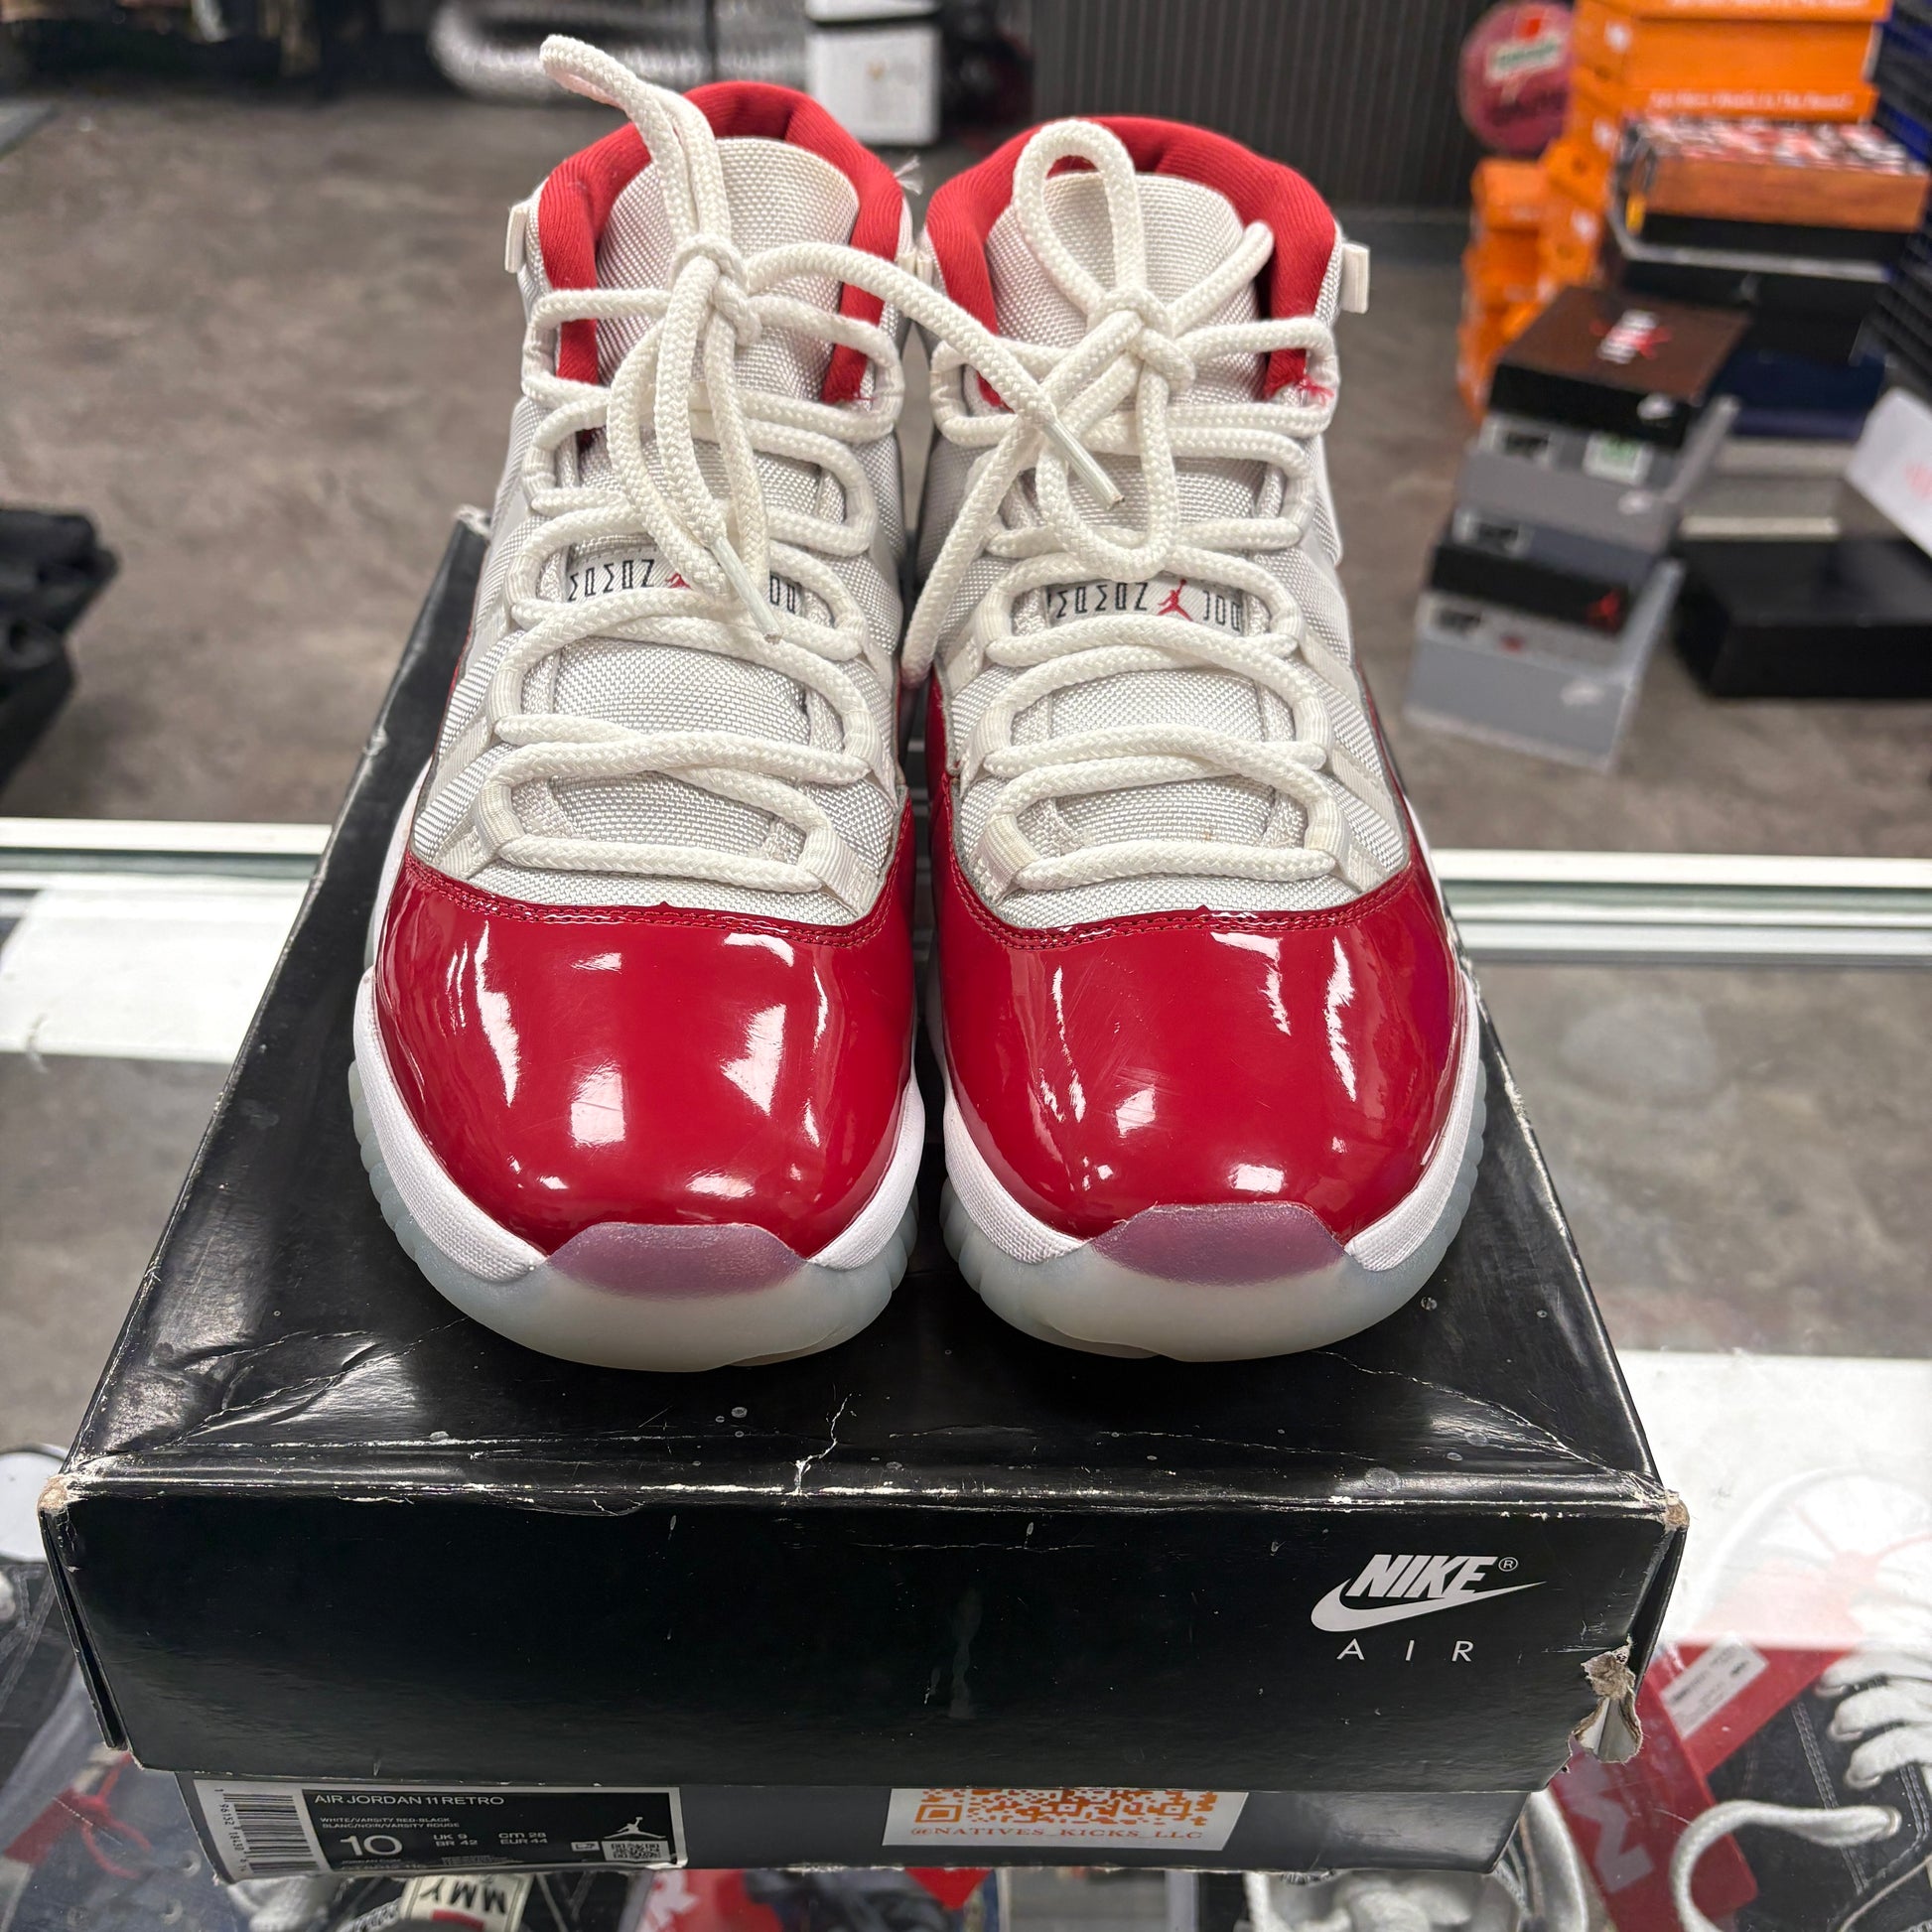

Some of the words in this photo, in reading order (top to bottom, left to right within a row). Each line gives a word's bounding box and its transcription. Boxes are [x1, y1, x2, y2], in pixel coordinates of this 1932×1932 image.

[1345, 1554, 1498, 1598] NIKE
[1336, 1638, 1474, 1662] AIR
[314, 1794, 345, 1805] AIR
[346, 1795, 422, 1805] JORDAN
[425, 1796, 439, 1805] 11
[442, 1796, 505, 1806] RETRO
[340, 1835, 403, 1857] 10
